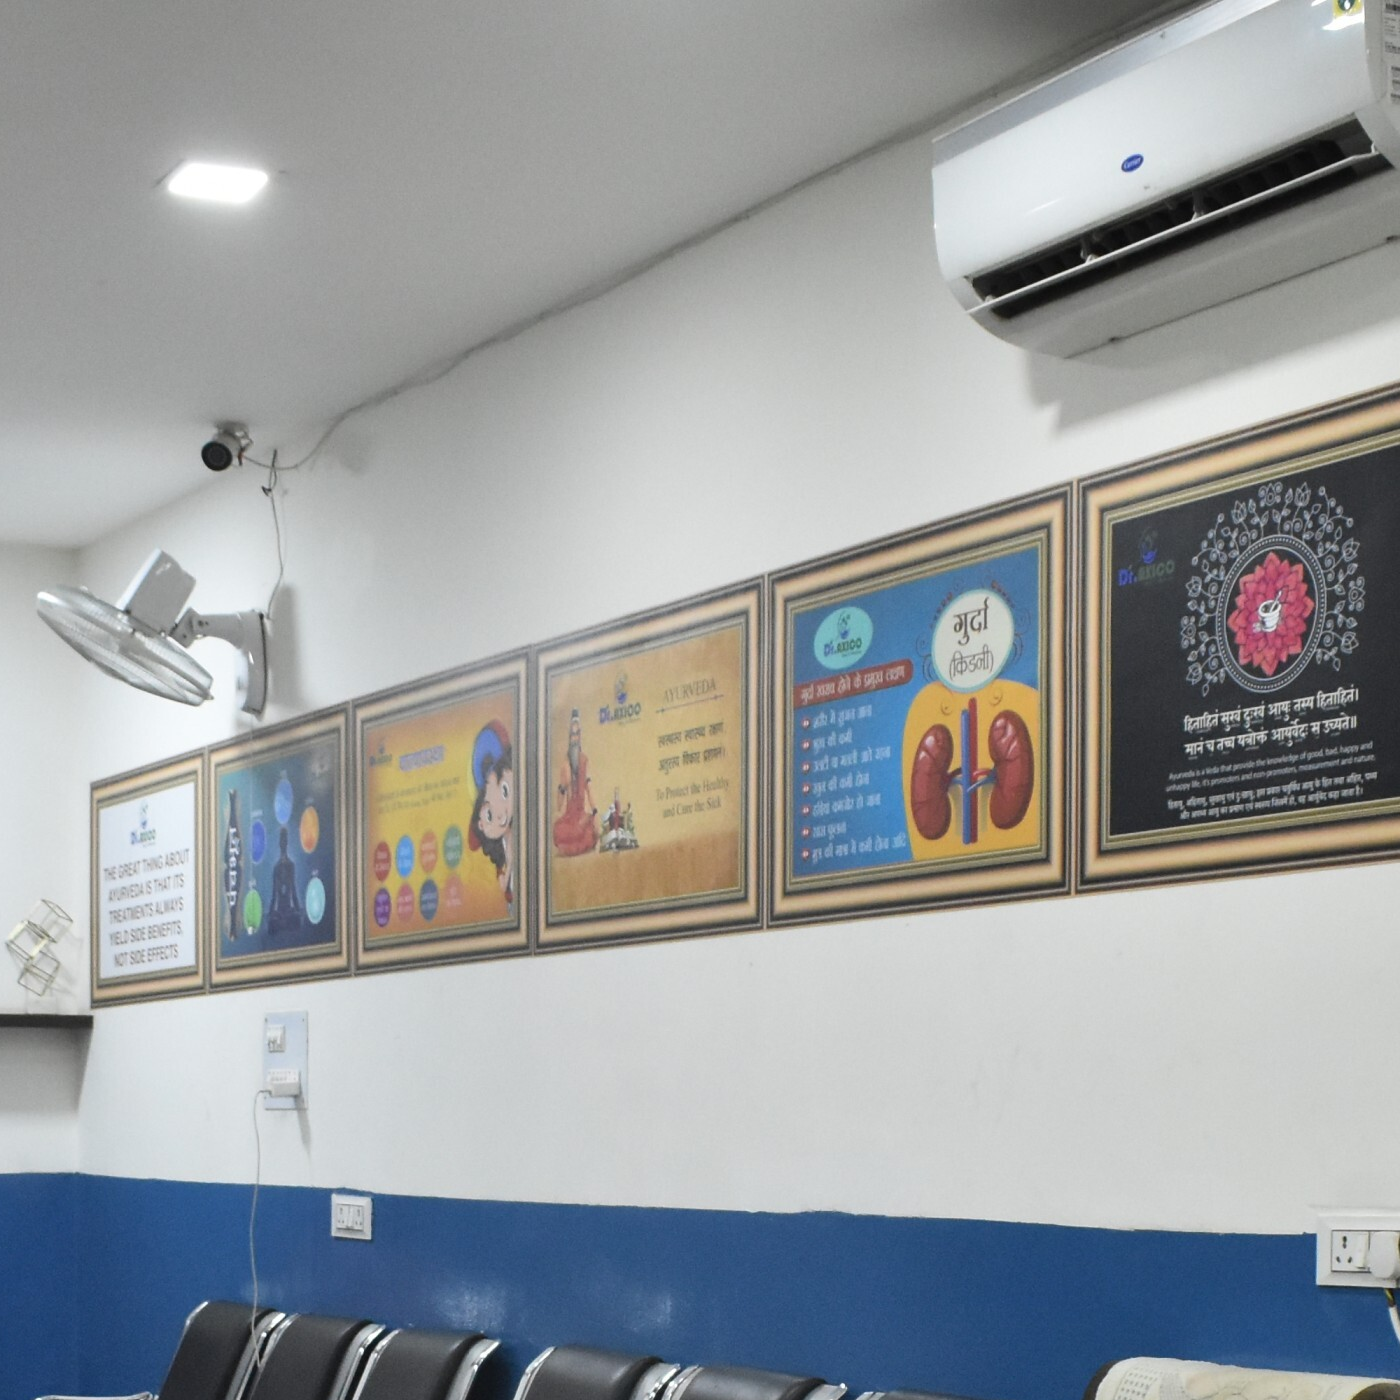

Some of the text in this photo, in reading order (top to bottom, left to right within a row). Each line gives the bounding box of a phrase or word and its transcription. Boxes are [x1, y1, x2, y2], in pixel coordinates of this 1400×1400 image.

[953, 597, 989, 645] गुर्दा
[949, 644, 994, 680] (किडनी)
[663, 677, 717, 703] AYURVEDA
[1166, 783, 1190, 792] unhappy
[1241, 772, 1252, 780] and
[1298, 759, 1340, 772] measurement
[1340, 756, 1353, 766] and
[1169, 770, 1195, 781] Ayurveda
[1220, 764, 1232, 773] that
[1233, 761, 1255, 772] provide
[1256, 758, 1265, 767] the
[1267, 754, 1298, 765] knowledge
[1300, 751, 1307, 759] of
[1340, 744, 1359, 754] happy
[1360, 740, 1373, 751] and
[656, 775, 729, 800] To Protect the Healthy
[663, 796, 721, 818] and Cure the Sick
[104, 848, 189, 880] THE GREAT THING ABOUT
[109, 873, 184, 902] AYURVEDA IS THAT ITS
[109, 896, 184, 924] TREATMENTS ALWAYS
[110, 930, 128, 945] YIELD
[130, 927, 145, 942] SIDE
[114, 944, 178, 967] NOT SIDE EFFECTS
